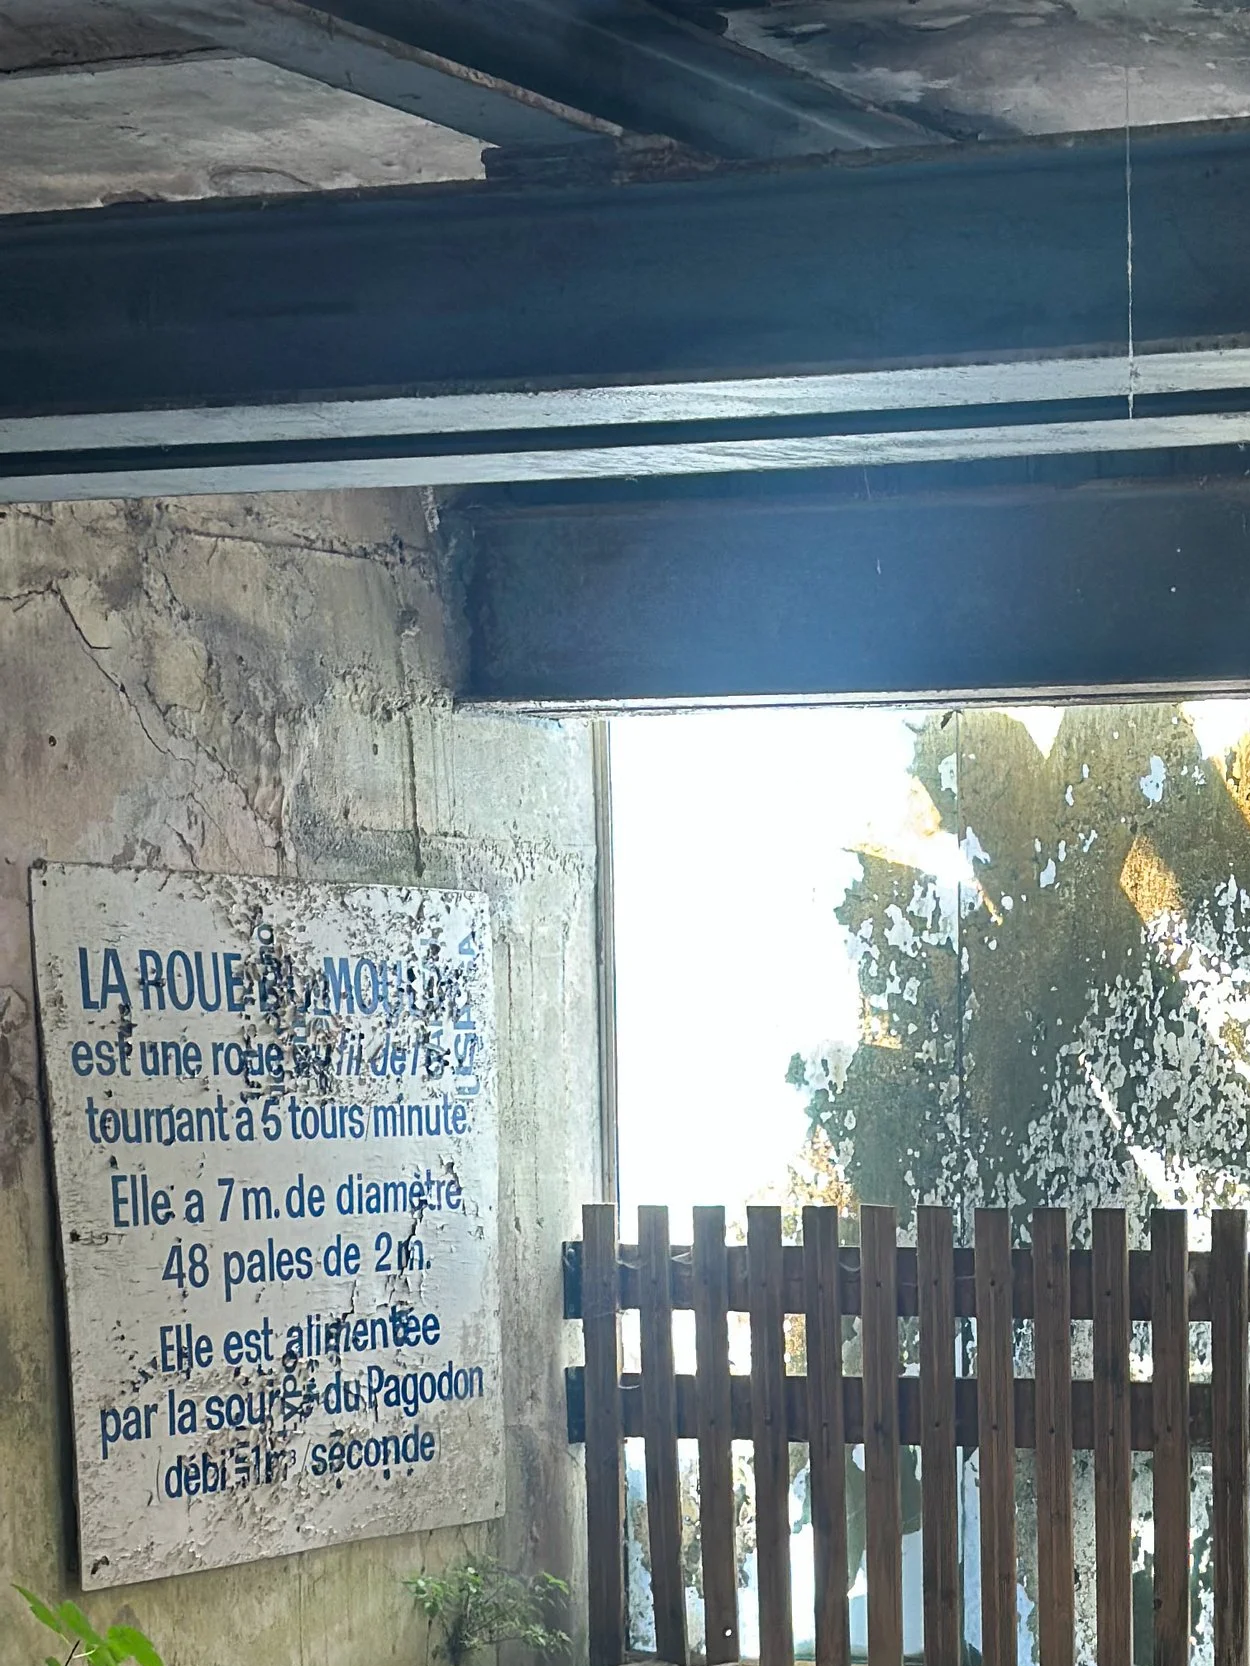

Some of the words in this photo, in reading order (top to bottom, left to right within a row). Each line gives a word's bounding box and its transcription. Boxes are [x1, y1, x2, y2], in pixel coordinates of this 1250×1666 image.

[78, 946, 131, 1011] LA
[138, 948, 245, 1012] ROUE
[71, 1033, 131, 1077] est
[141, 1041, 202, 1077] une
[86, 1096, 228, 1143] tournant
[261, 1097, 282, 1141] 5
[112, 1174, 172, 1227] Elle
[185, 1189, 204, 1223] a
[286, 1173, 325, 1217] de
[336, 1169, 462, 1216] diamètre
[162, 1242, 209, 1289] 48
[223, 1238, 312, 1302] pales
[324, 1234, 360, 1277] de
[160, 1324, 212, 1373] Elle
[224, 1317, 273, 1364] est
[100, 1404, 157, 1460] par
[170, 1389, 197, 1436] la
[324, 1375, 360, 1416] du
[368, 1361, 484, 1418] Pagodon
